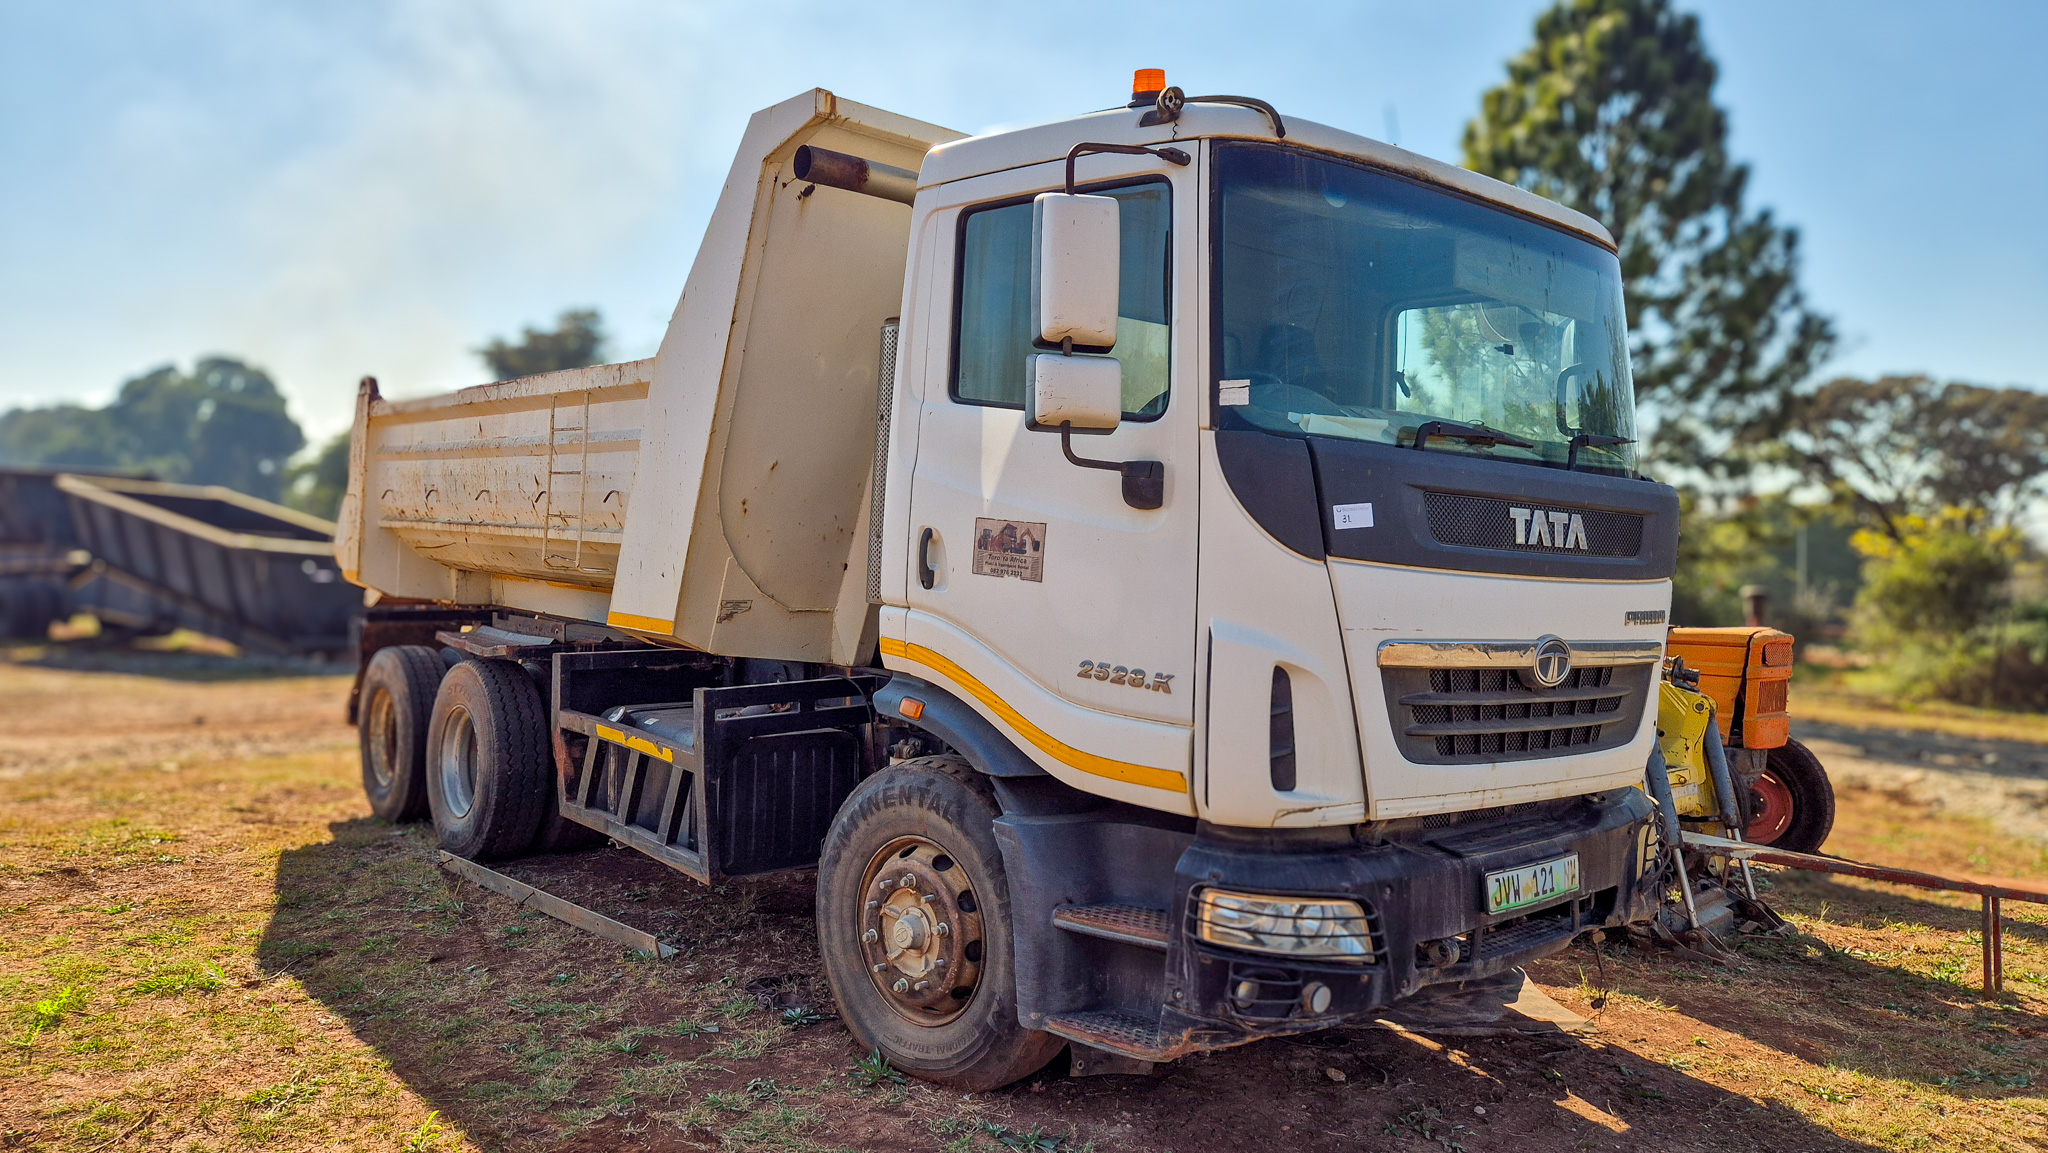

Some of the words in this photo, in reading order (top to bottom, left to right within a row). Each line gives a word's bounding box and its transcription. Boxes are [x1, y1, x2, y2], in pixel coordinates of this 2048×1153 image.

[1509, 507, 1588, 550] TATA
[1010, 556, 1027, 564] Africa
[1077, 660, 1175, 694] 2528.K
[1494, 873, 1520, 907] JVW
[1533, 866, 1555, 897] 121
